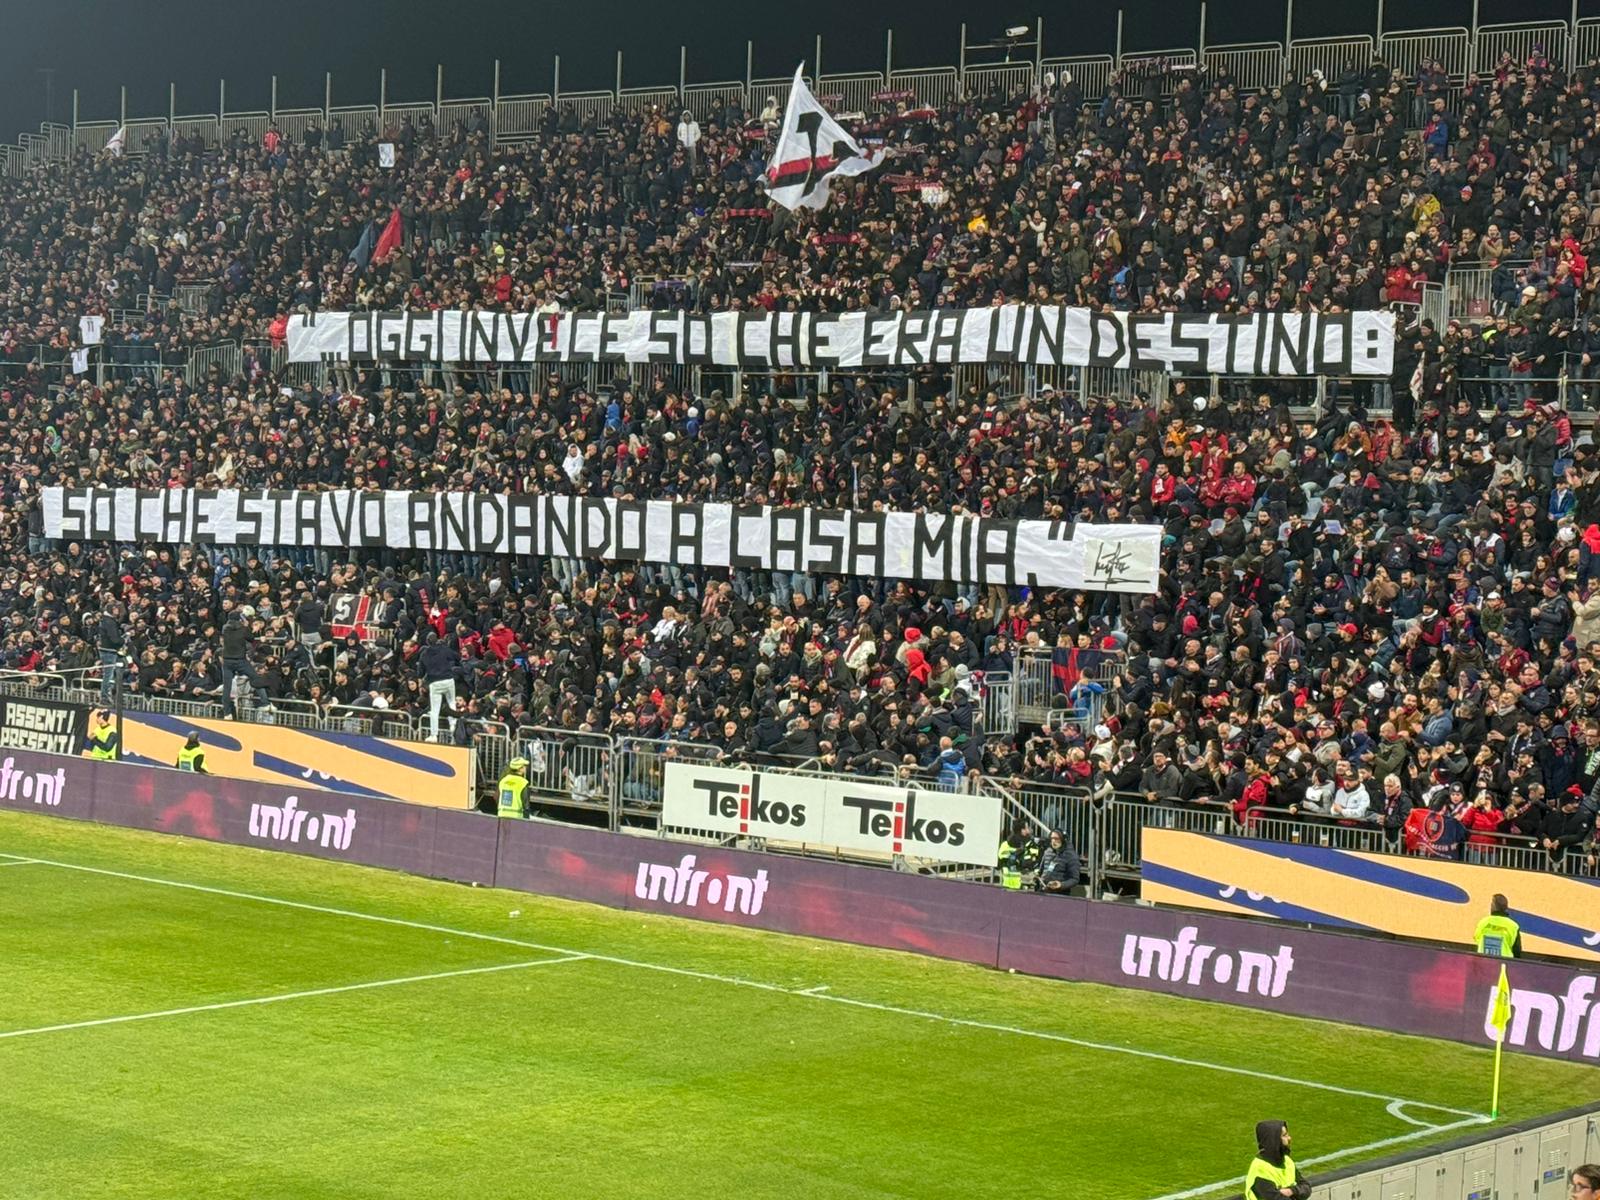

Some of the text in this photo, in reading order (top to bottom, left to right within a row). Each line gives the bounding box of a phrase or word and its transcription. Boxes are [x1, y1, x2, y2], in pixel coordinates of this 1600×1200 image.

[461, 311, 627, 363] INVECE
[648, 311, 712, 364] SO
[737, 312, 840, 366] CHE
[863, 310, 962, 365] ERA
[987, 305, 1066, 365] UN
[62, 488, 115, 540] SO
[136, 489, 218, 543] CHE
[236, 490, 387, 547] STAVO
[408, 492, 648, 560] ANDANDO
[671, 501, 703, 565] A
[731, 504, 886, 577] CASA
[0, 726, 76, 755] PRESENTI
[5, 702, 76, 734] ASSENTI
[248, 795, 357, 851] infront
[692, 773, 807, 834] Teikos
[842, 791, 966, 853] Teikos
[634, 854, 770, 916] infront
[1120, 926, 1295, 998] infront
